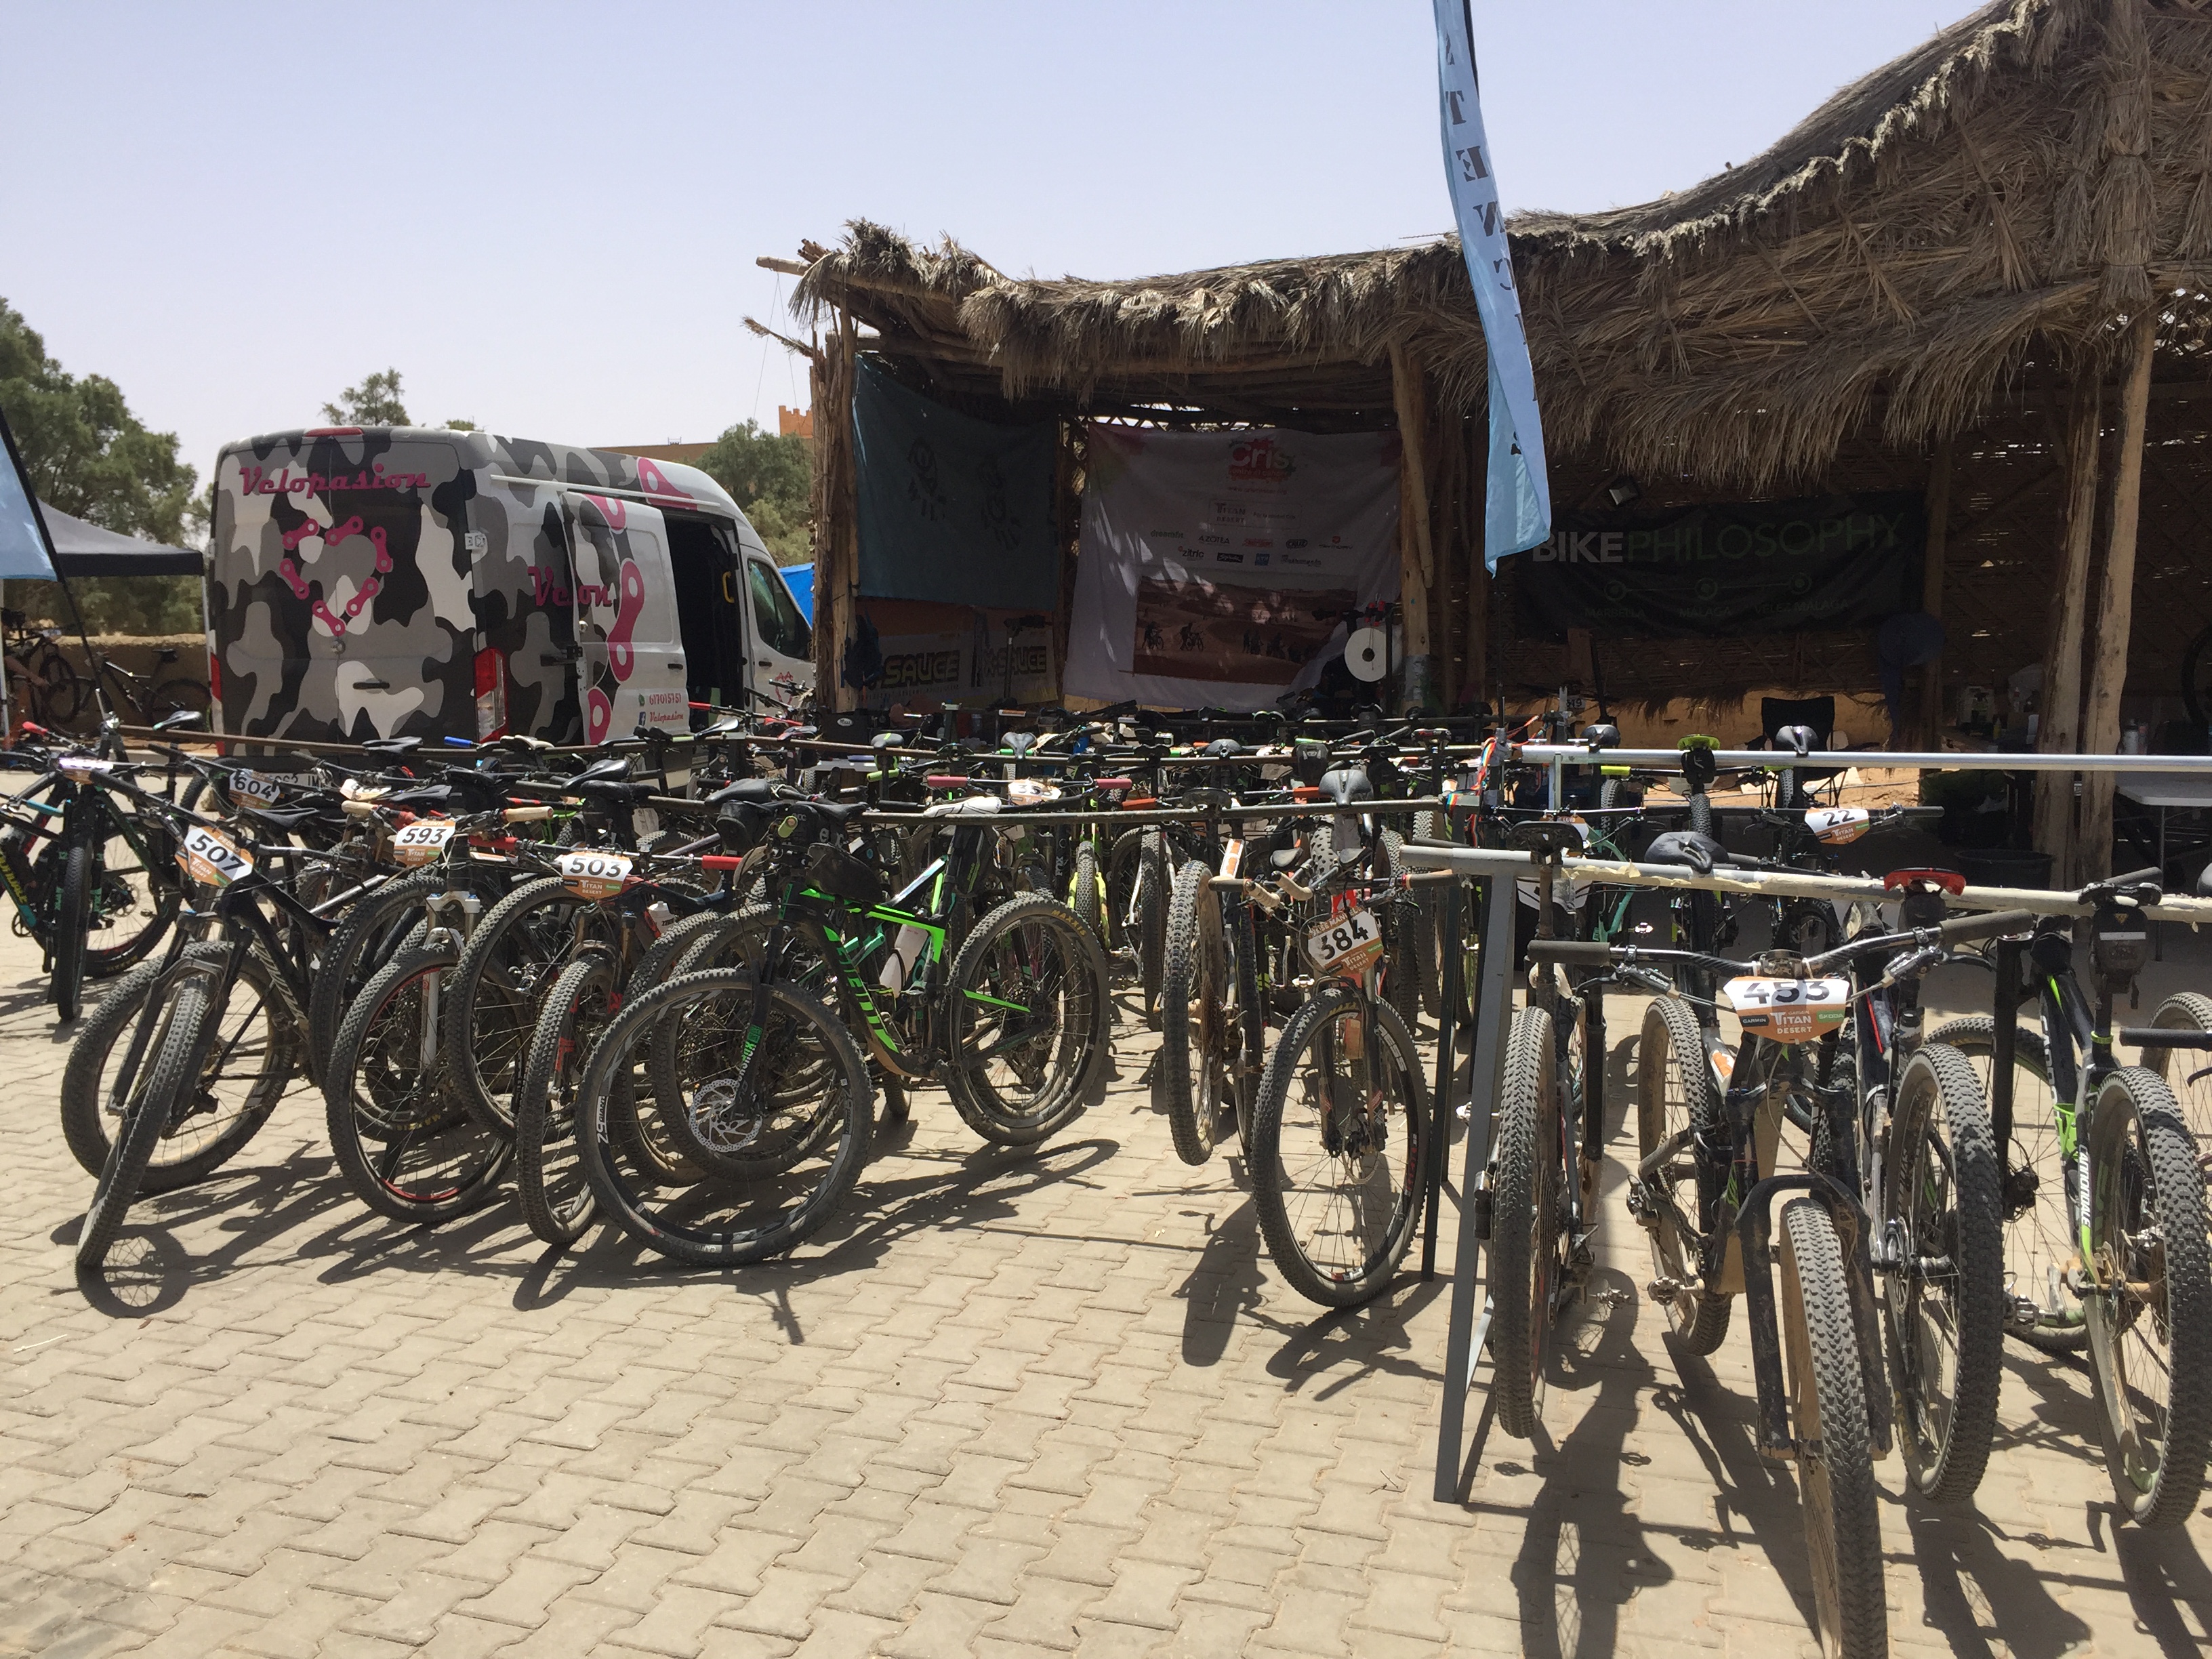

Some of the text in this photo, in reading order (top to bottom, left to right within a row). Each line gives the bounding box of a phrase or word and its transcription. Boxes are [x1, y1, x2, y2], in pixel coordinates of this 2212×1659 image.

[239, 464, 431, 498] Velopasion
[1198, 535, 1231, 544] AZOTEA
[1822, 810, 1856, 827] 22
[402, 827, 447, 844] 593
[190, 834, 246, 872] 507
[569, 857, 623, 878] 503
[1054, 856, 1064, 876] FOX
[1051, 909, 1087, 936] MAXXIS
[1319, 920, 1369, 960] 384
[1744, 981, 1830, 1004] 453
[1770, 1011, 1812, 1025] TITAN
[1777, 1026, 1813, 1034] DESERT
